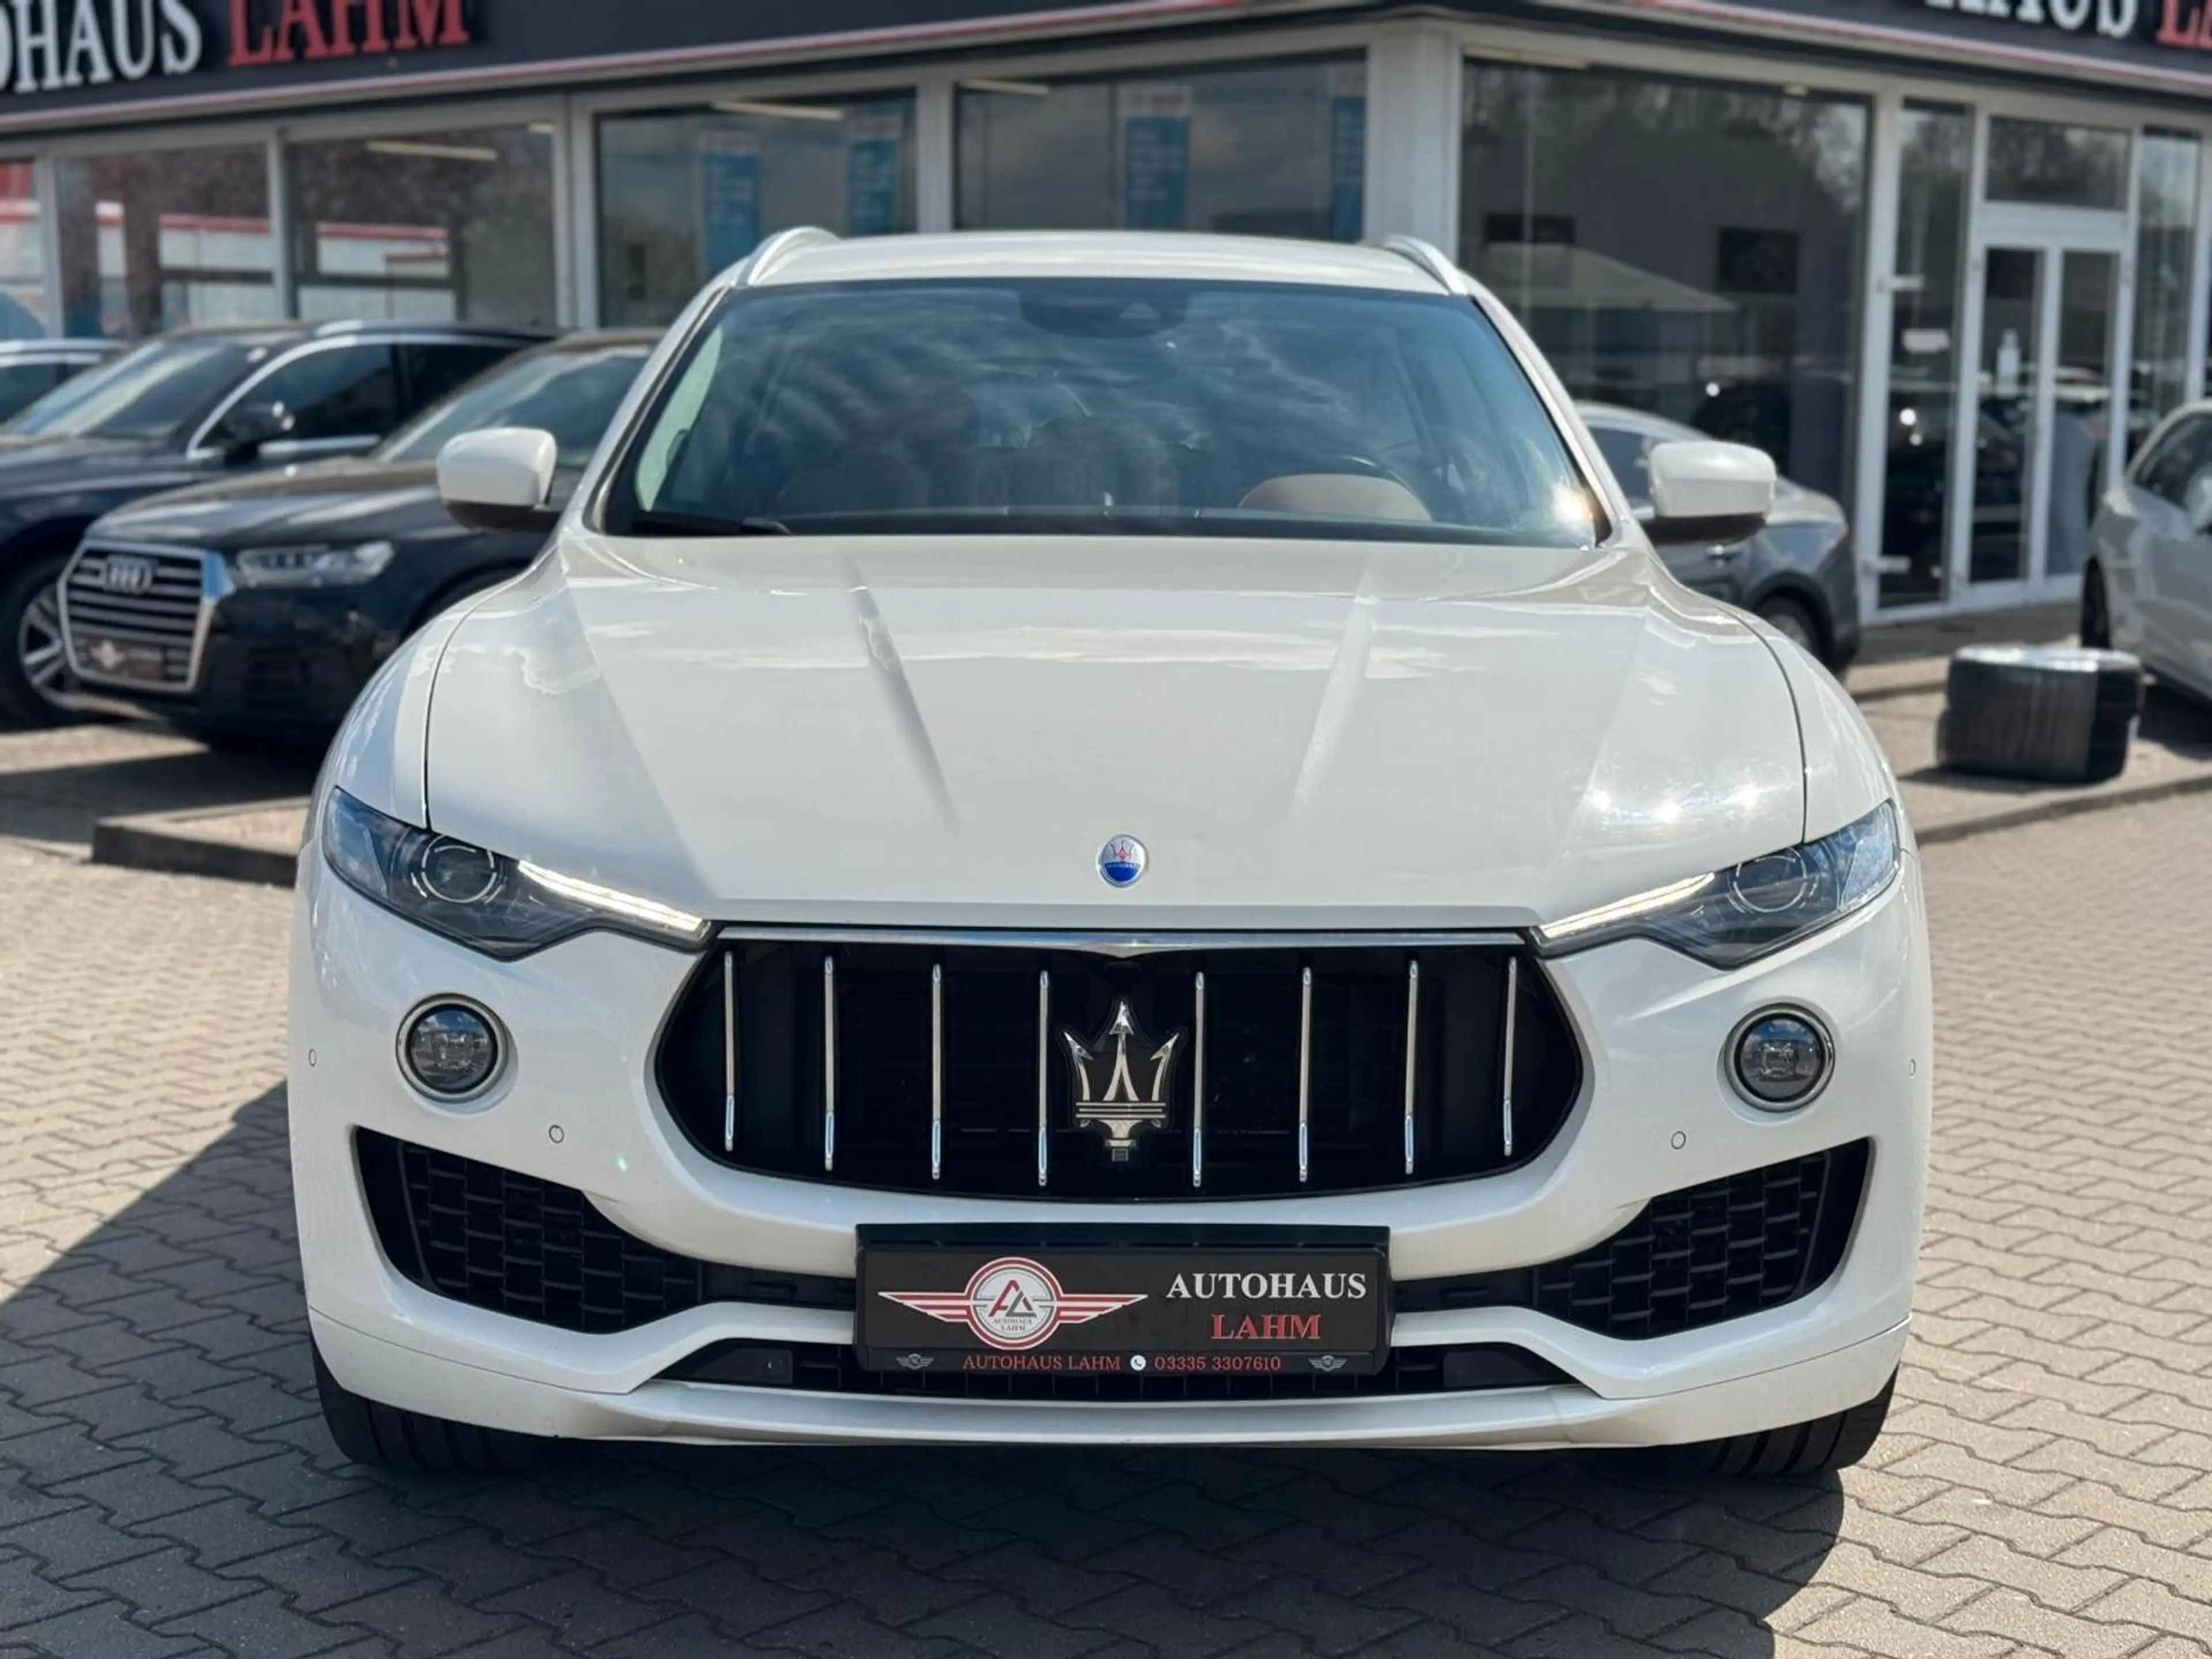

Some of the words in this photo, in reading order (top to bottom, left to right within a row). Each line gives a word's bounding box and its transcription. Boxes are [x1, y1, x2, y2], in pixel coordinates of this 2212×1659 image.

[229, 0, 468, 65] LAHM
[1165, 1273, 1367, 1299] AUTOHAUS
[1210, 1314, 1321, 1340] LAHM
[963, 1355, 1062, 1370] AUTOHAUS
[1067, 1355, 1122, 1371] LAHM
[1154, 1355, 1206, 1371] 03335
[1211, 1355, 1282, 1371] 3307610
